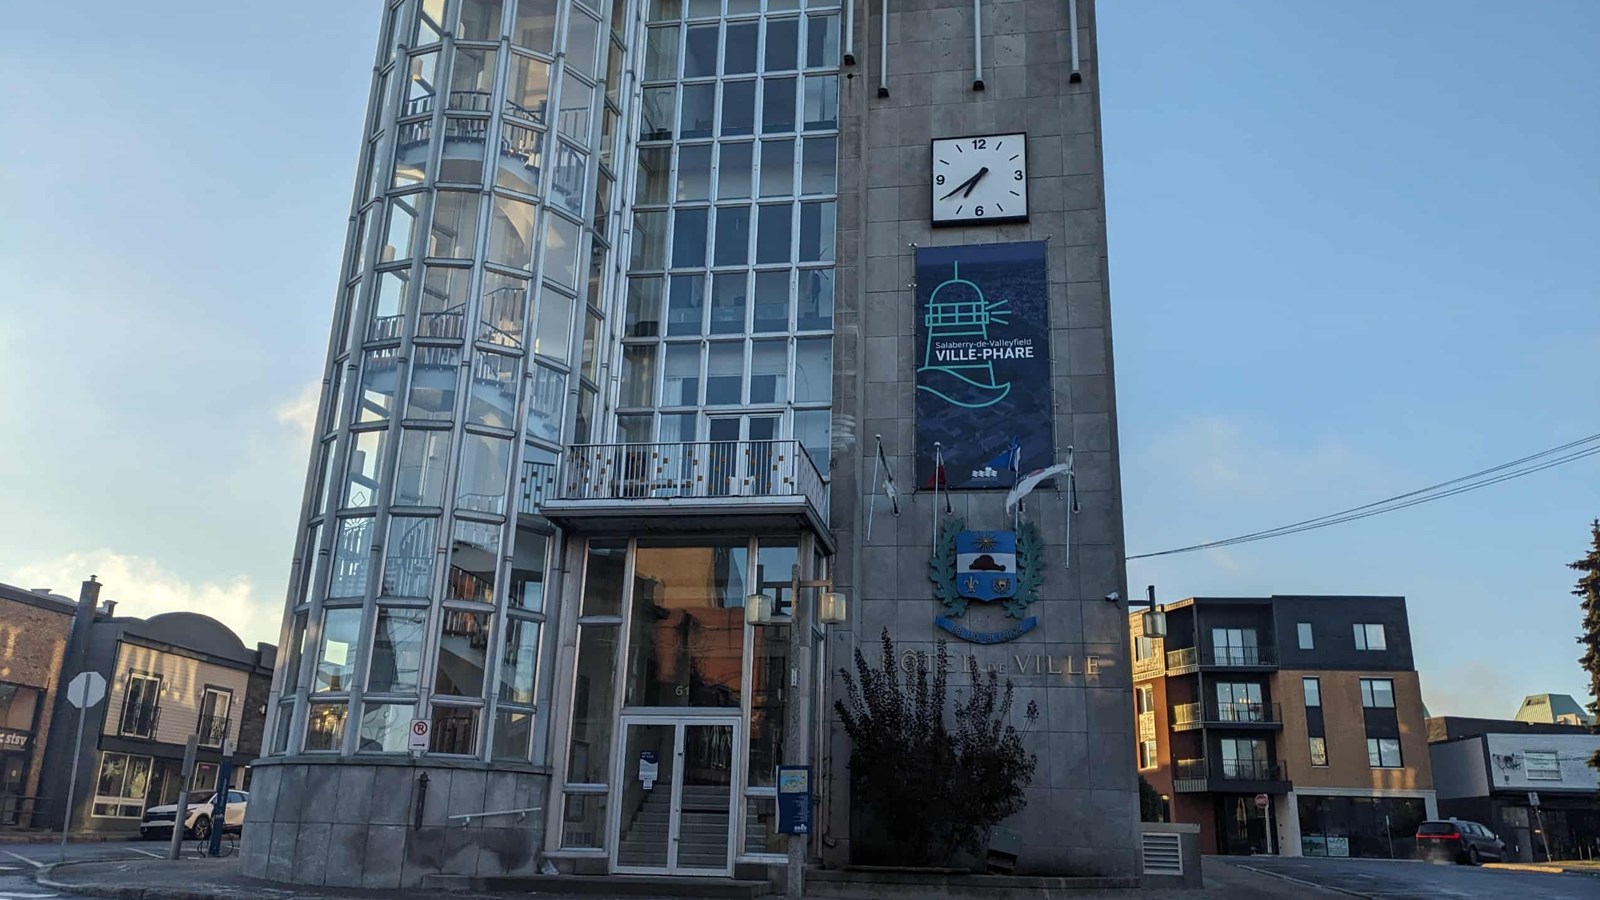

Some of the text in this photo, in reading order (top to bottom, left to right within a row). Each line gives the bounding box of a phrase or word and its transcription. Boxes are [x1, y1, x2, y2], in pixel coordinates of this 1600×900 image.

[972, 139, 987, 150] 12
[936, 174, 946, 186] 9
[1014, 169, 1024, 181] 3
[974, 205, 985, 217] 6
[935, 338, 1032, 350] Salaberry-de-Valleyfield
[935, 346, 1035, 362] VILLE-PHARE
[1013, 655, 1103, 676] VILLE
